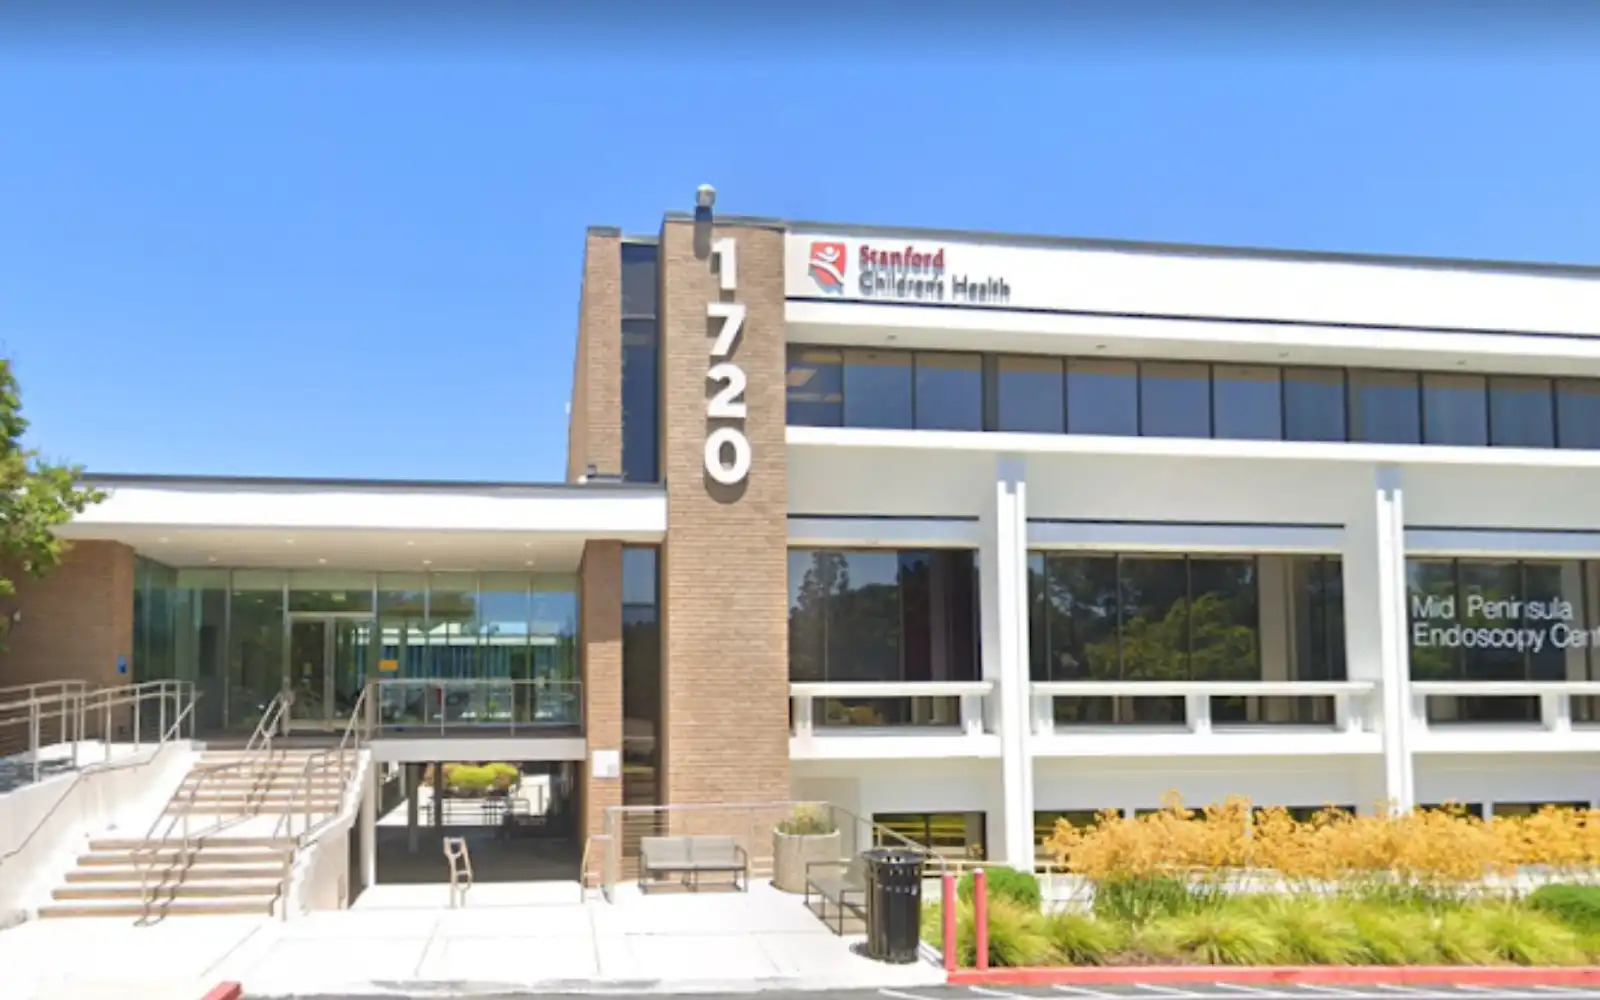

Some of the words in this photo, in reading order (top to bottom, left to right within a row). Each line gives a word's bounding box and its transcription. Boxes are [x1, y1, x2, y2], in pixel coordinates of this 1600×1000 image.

[859, 245, 945, 270] Stanford
[952, 274, 1011, 301] Health
[704, 237, 751, 484] 1720
[1412, 595, 1454, 619] Mid
[1413, 623, 1545, 652] Endoscopy
